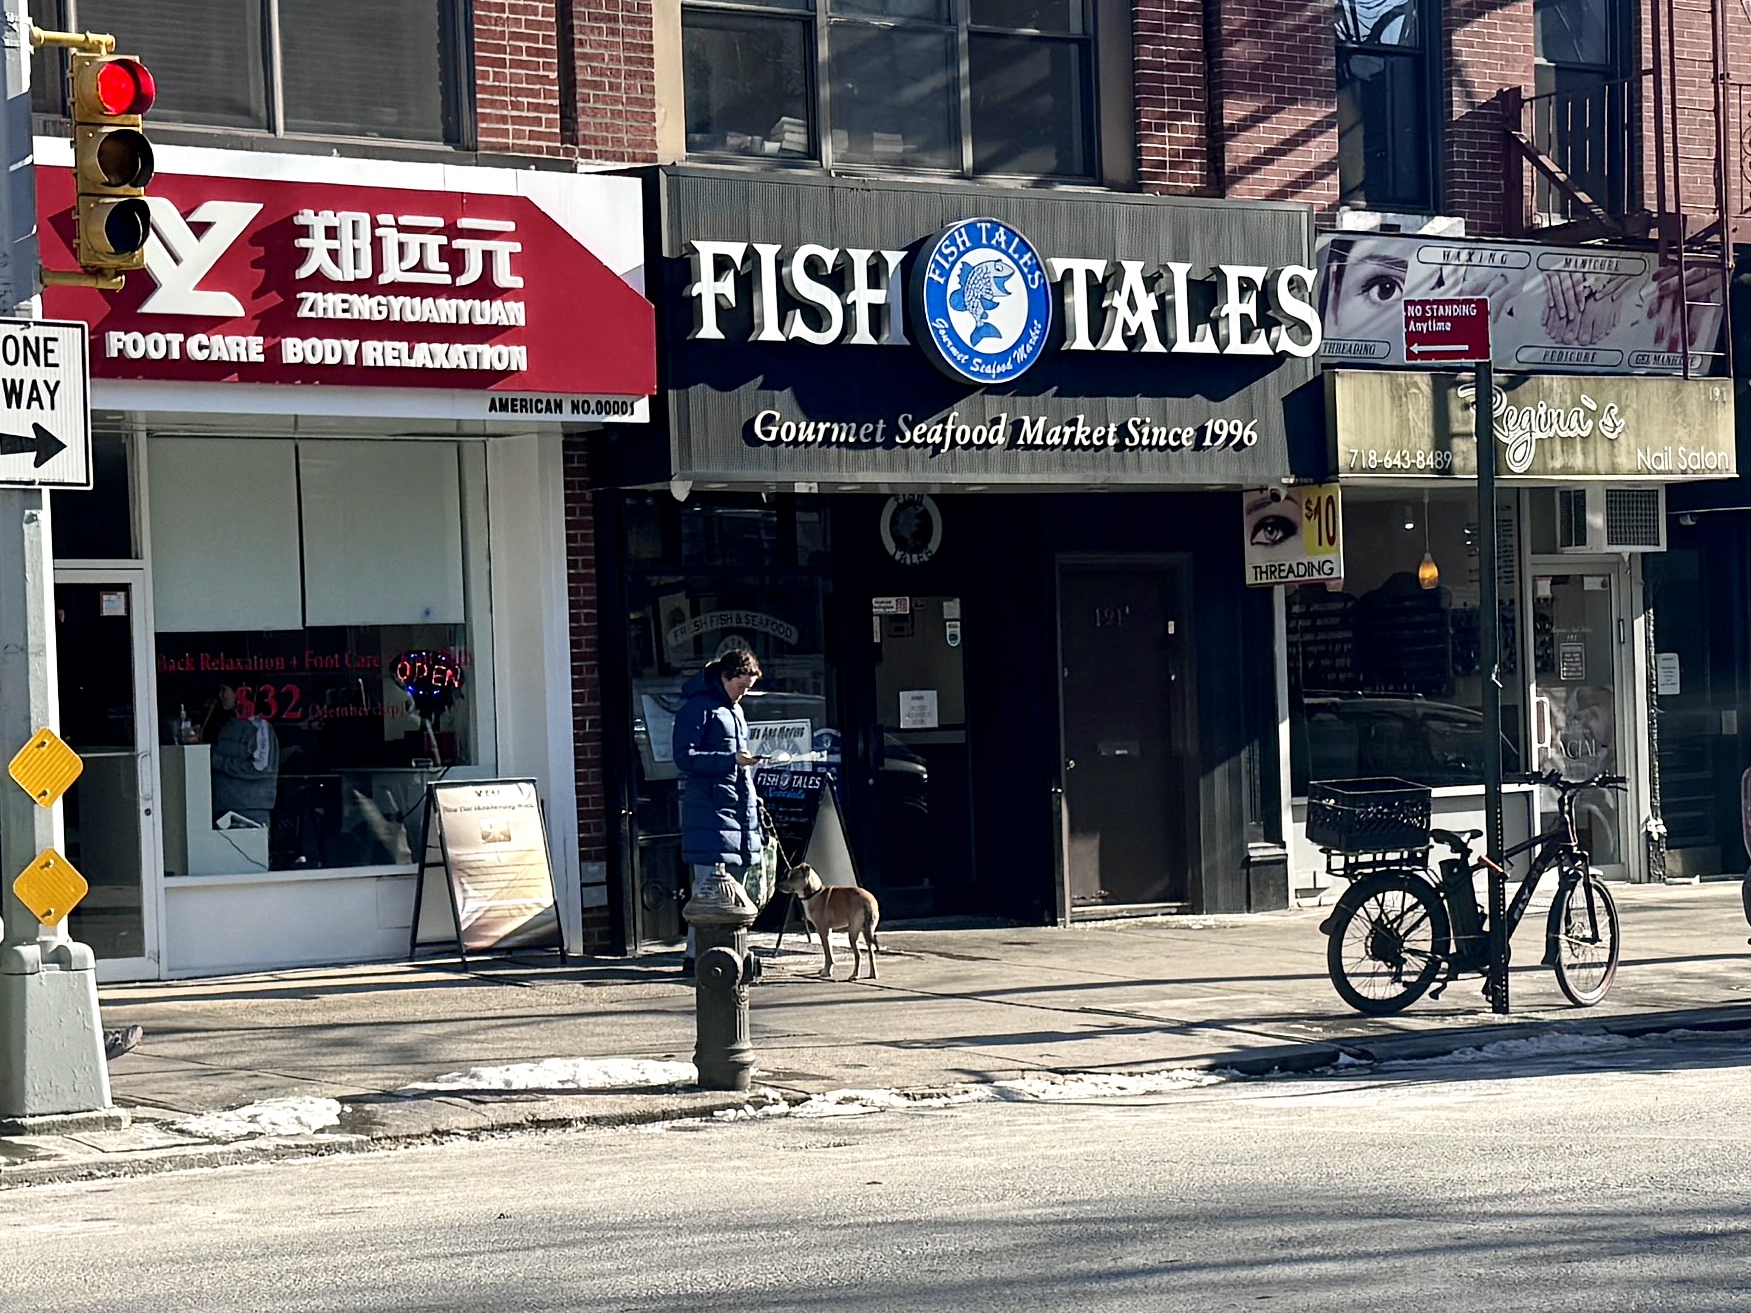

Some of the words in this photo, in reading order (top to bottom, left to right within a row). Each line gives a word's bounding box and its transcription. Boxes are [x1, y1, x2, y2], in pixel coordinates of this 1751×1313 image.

[293, 208, 525, 288] 郑远元
[927, 227, 972, 286] FISH
[976, 221, 1045, 290] TALES
[1441, 250, 1510, 265] WAXING
[1562, 257, 1622, 272] MANICURE
[295, 292, 526, 327] ZHENGYUANYUAN
[689, 240, 911, 346] FISH
[1047, 257, 1325, 359] TALES
[1407, 303, 1423, 317] NO
[1424, 303, 1478, 317] STANDING
[1409, 319, 1452, 334] Anytime
[1, 334, 61, 369] ONE
[105, 330, 186, 362] FOOT
[186, 334, 265, 364] CARE
[280, 337, 361, 368] BODY
[363, 340, 529, 373] RELAXATION
[932, 317, 970, 364] Gourmet
[969, 357, 1014, 379] Seafood
[1012, 319, 1044, 365] Market
[1322, 342, 1376, 356] THREADING
[1542, 350, 1598, 363] PEDICURE
[1, 377, 62, 412] WAY
[488, 395, 564, 416] AMERICAN
[569, 397, 637, 417] NO.00001
[753, 409, 887, 444] Gourmet
[895, 412, 1008, 454] Seafood
[1016, 415, 1118, 447] Market
[1124, 417, 1194, 447] Since
[1201, 419, 1259, 448] 1996
[1348, 448, 1453, 471] 718-643-8489
[1636, 448, 1673, 471] Nail
[1677, 448, 1730, 471] Salon
[1304, 494, 1336, 547] $10
[1251, 559, 1335, 582] THREADING
[157, 652, 195, 674] Back
[200, 650, 285, 672] Relaxation
[304, 649, 342, 670] Foot
[344, 650, 382, 669] Care
[396, 660, 463, 689] OPEN
[234, 684, 304, 721] $32
[757, 772, 780, 786] FISH
[791, 775, 822, 789] TALES
